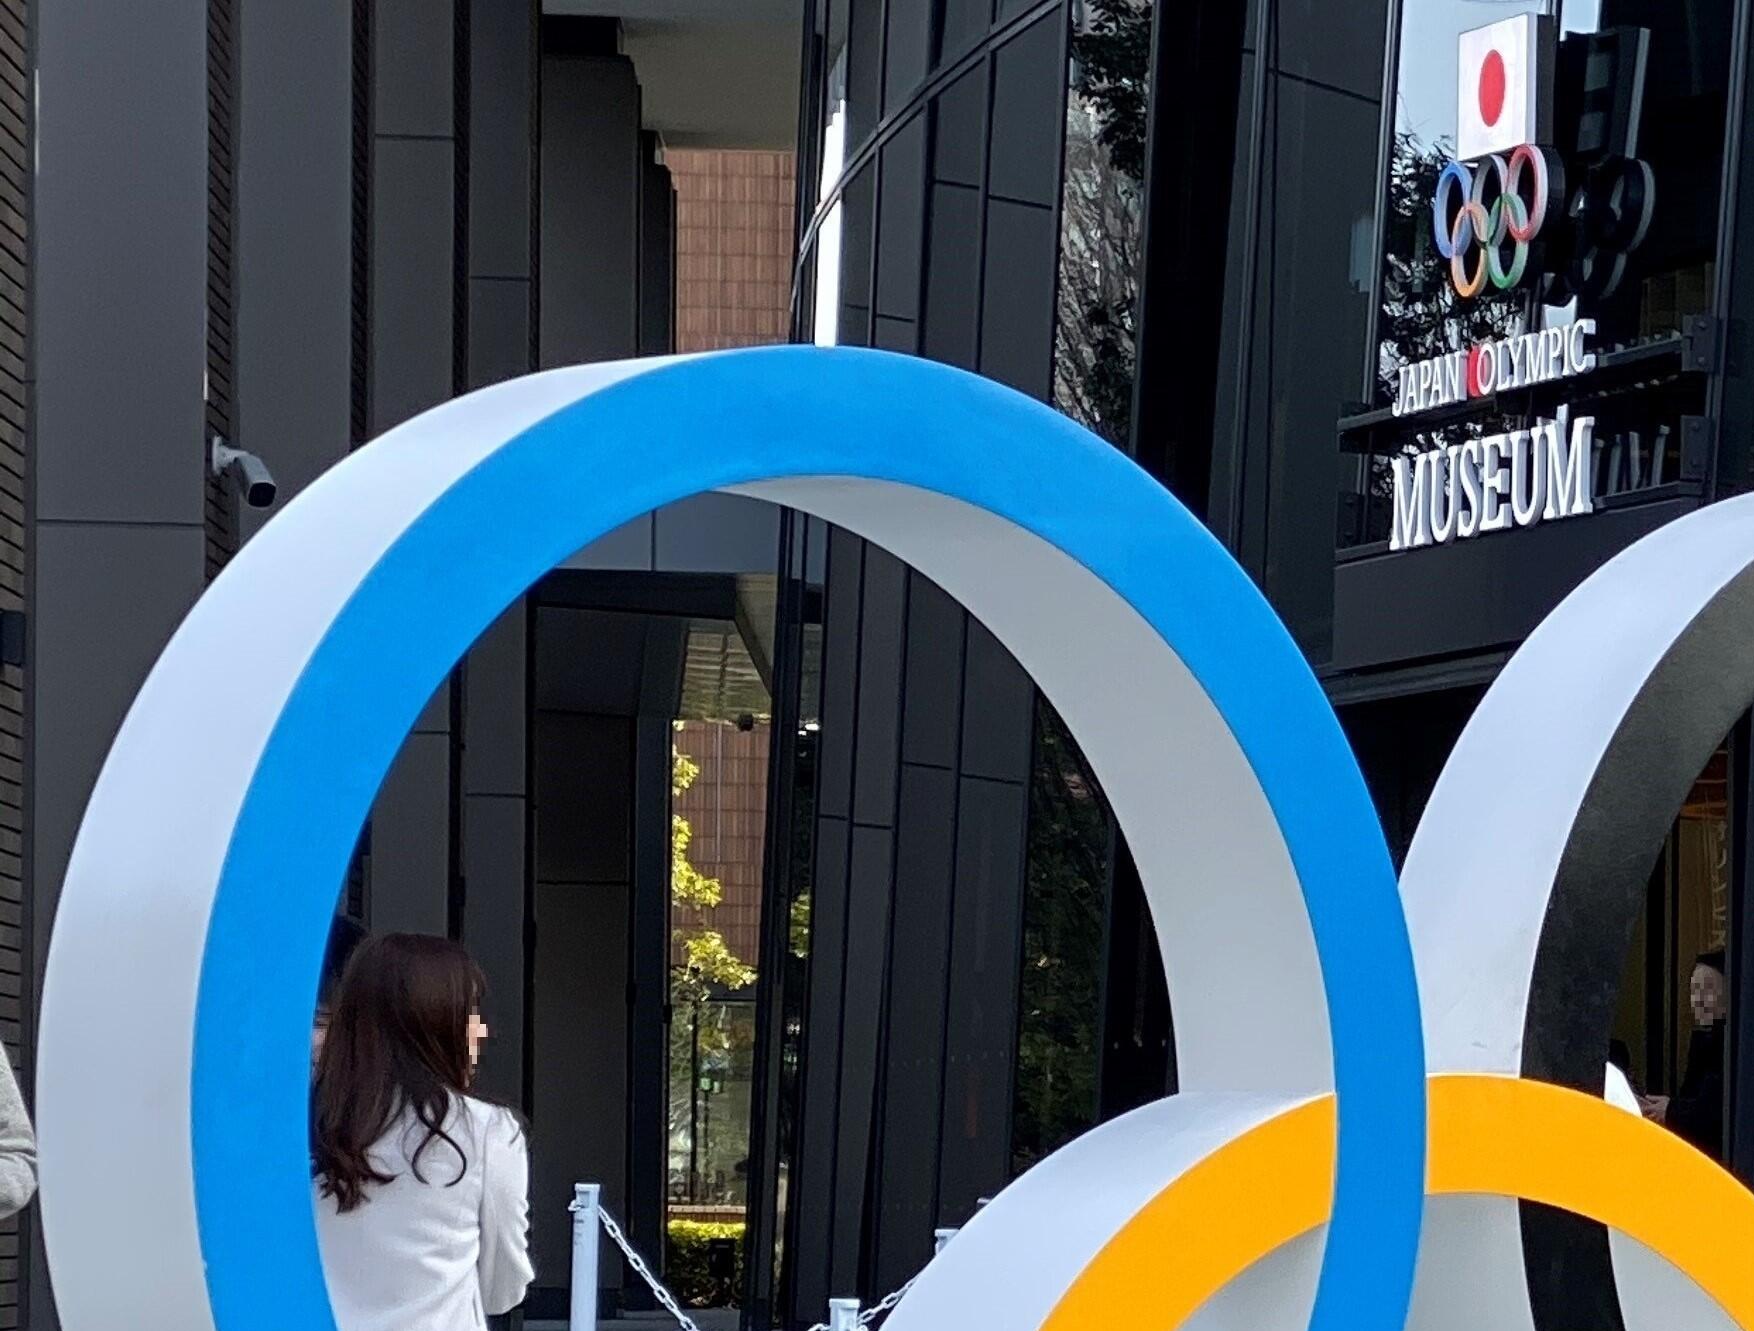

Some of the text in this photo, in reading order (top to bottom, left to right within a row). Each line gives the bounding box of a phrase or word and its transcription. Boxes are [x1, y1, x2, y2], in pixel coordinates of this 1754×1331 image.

[1392, 318, 1597, 417] JAPAN OLYMPIC
[1389, 415, 1596, 551] MUSEUM
